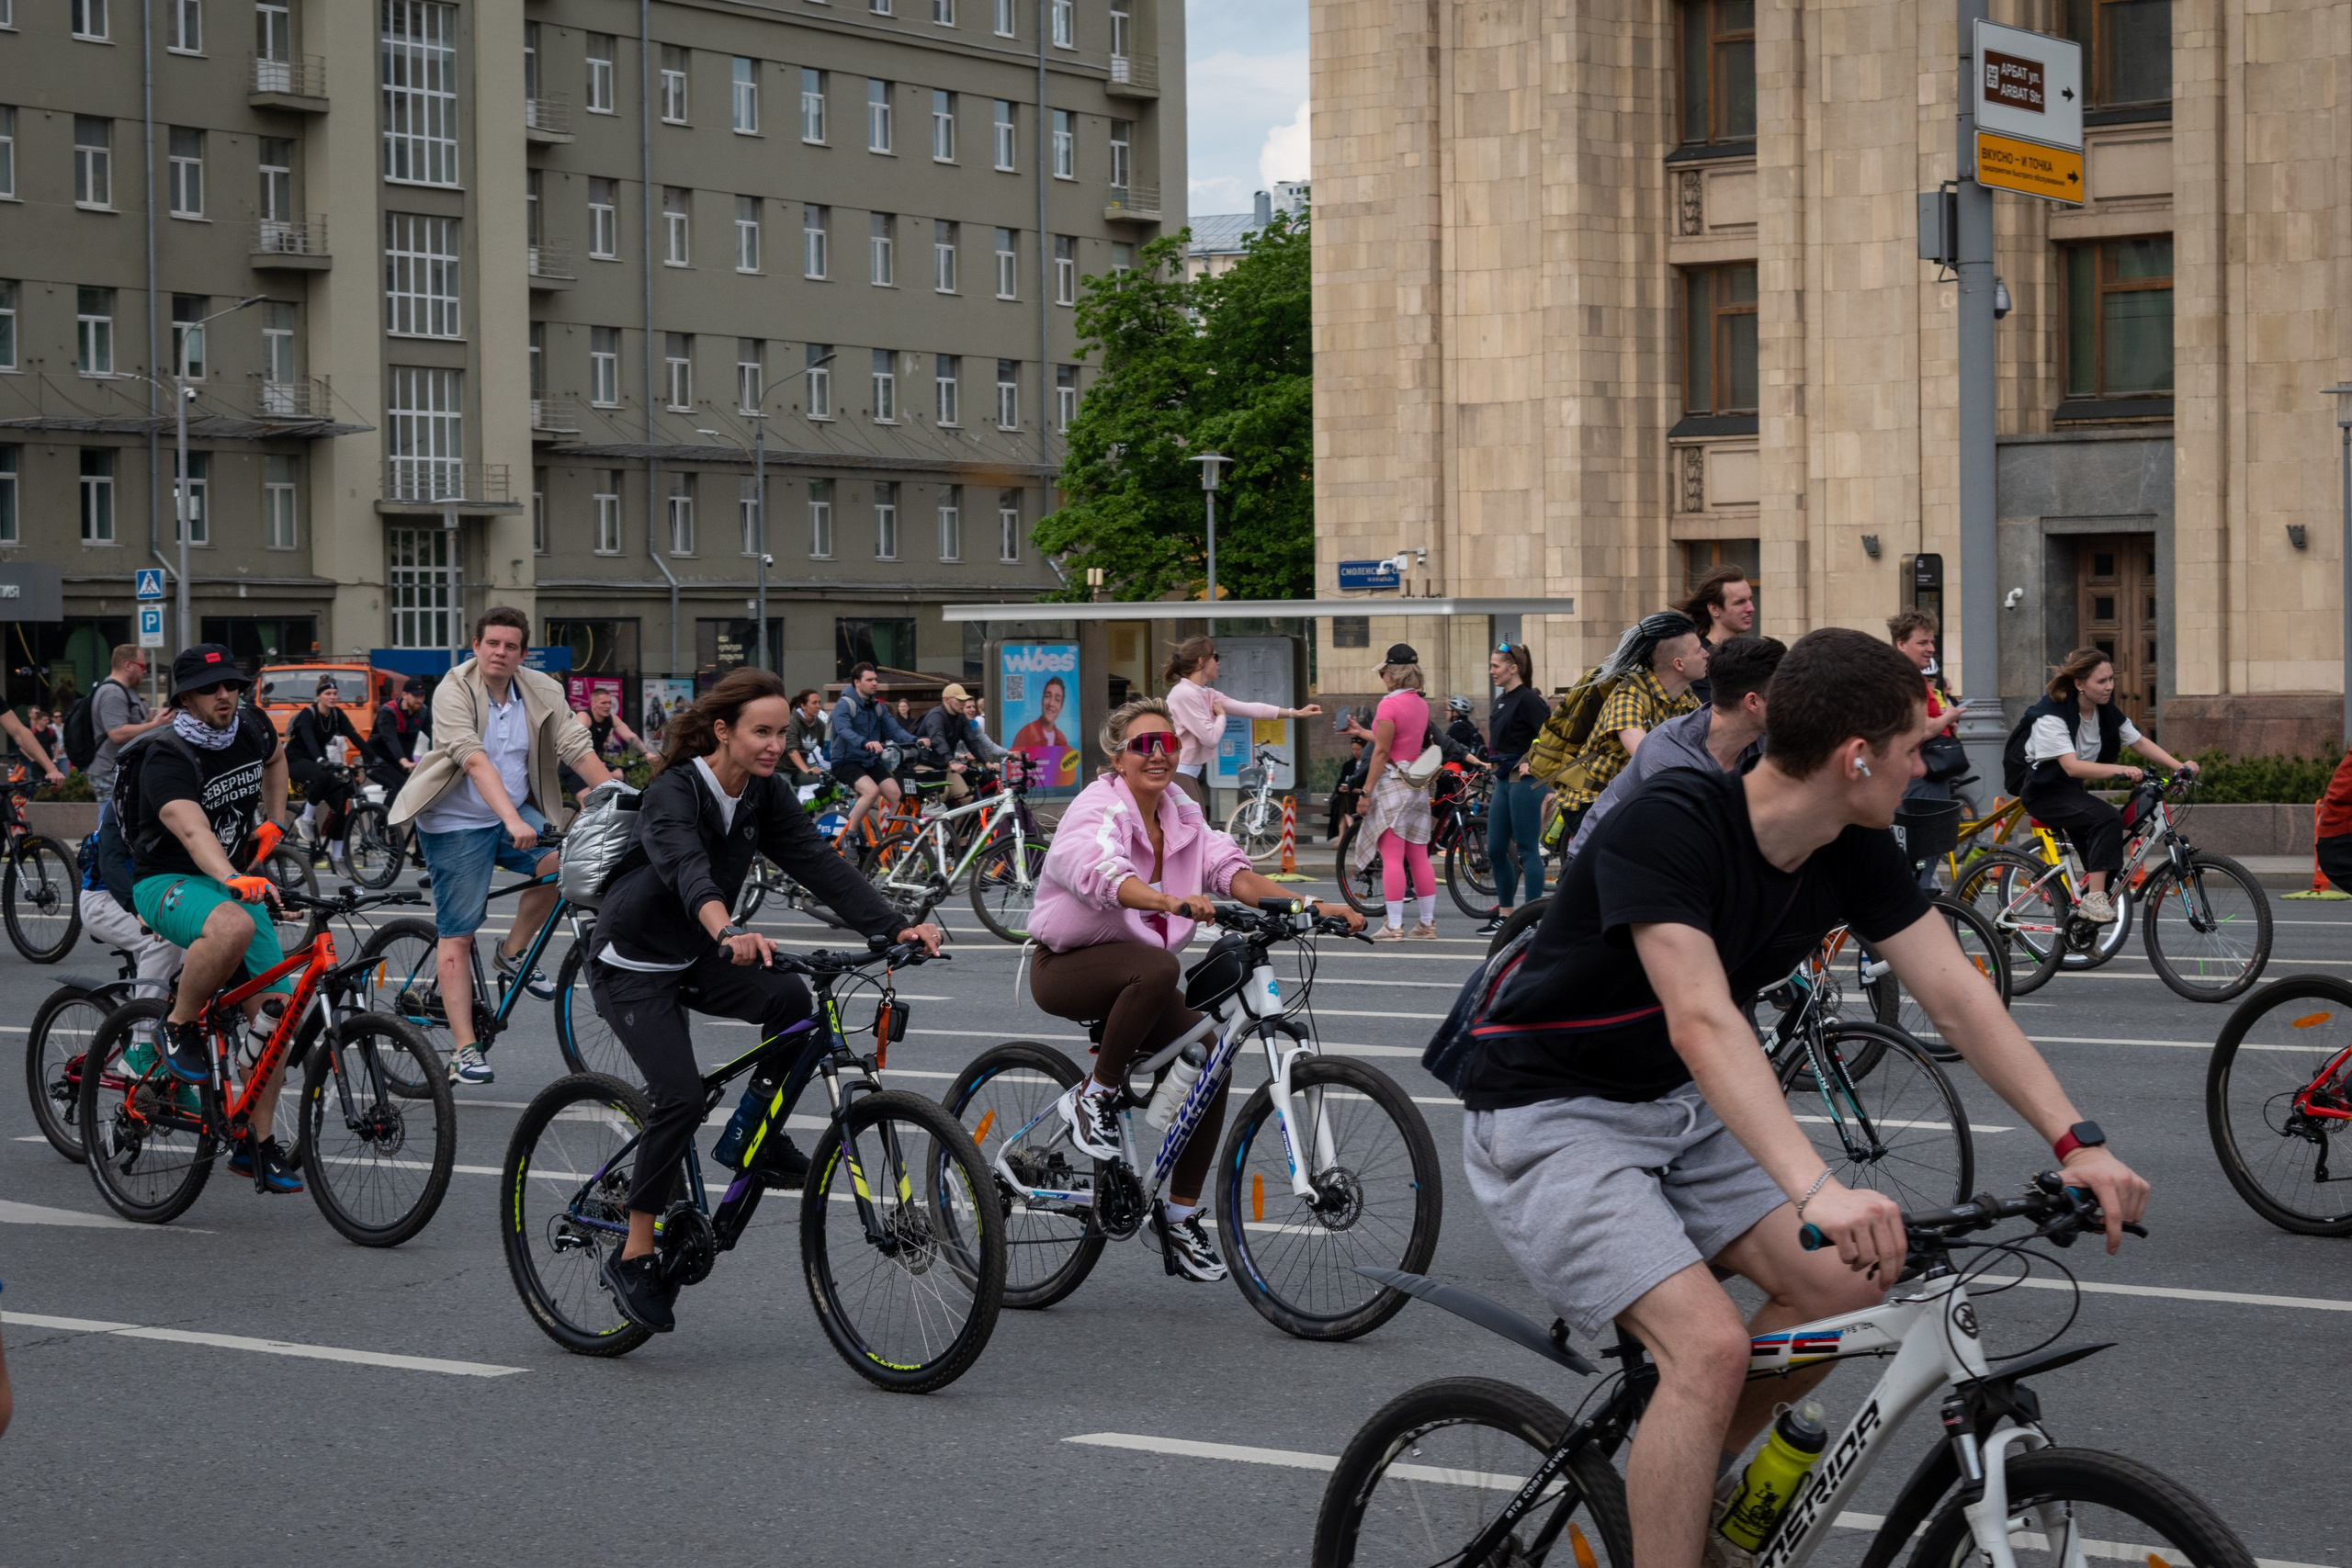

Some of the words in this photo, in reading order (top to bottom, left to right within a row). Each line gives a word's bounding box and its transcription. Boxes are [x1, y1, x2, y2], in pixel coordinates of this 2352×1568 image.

[2000, 62, 2029, 81] АРБАТ
[2029, 71, 2041, 85] ул.
[2000, 84, 2029, 100] ARBAT
[2030, 90, 2043, 105] Str.
[1981, 147, 2013, 164] ВКУСНО
[2021, 156, 2027, 167] И
[2029, 157, 2053, 173] ТОЧКА
[1061, 751, 1080, 770] WOW
[201, 763, 264, 806] СЕВЕРНЫЙ
[205, 783, 262, 811] ЧЕЛОВЕК
[1804, 1040, 1830, 1089] Bianchi
[1838, 1061, 1856, 1089] Bianchi
[866, 1351, 921, 1370] ALLTERRA
[1521, 1472, 1544, 1499] COMP
[1544, 1447, 1569, 1473] LEVEL
